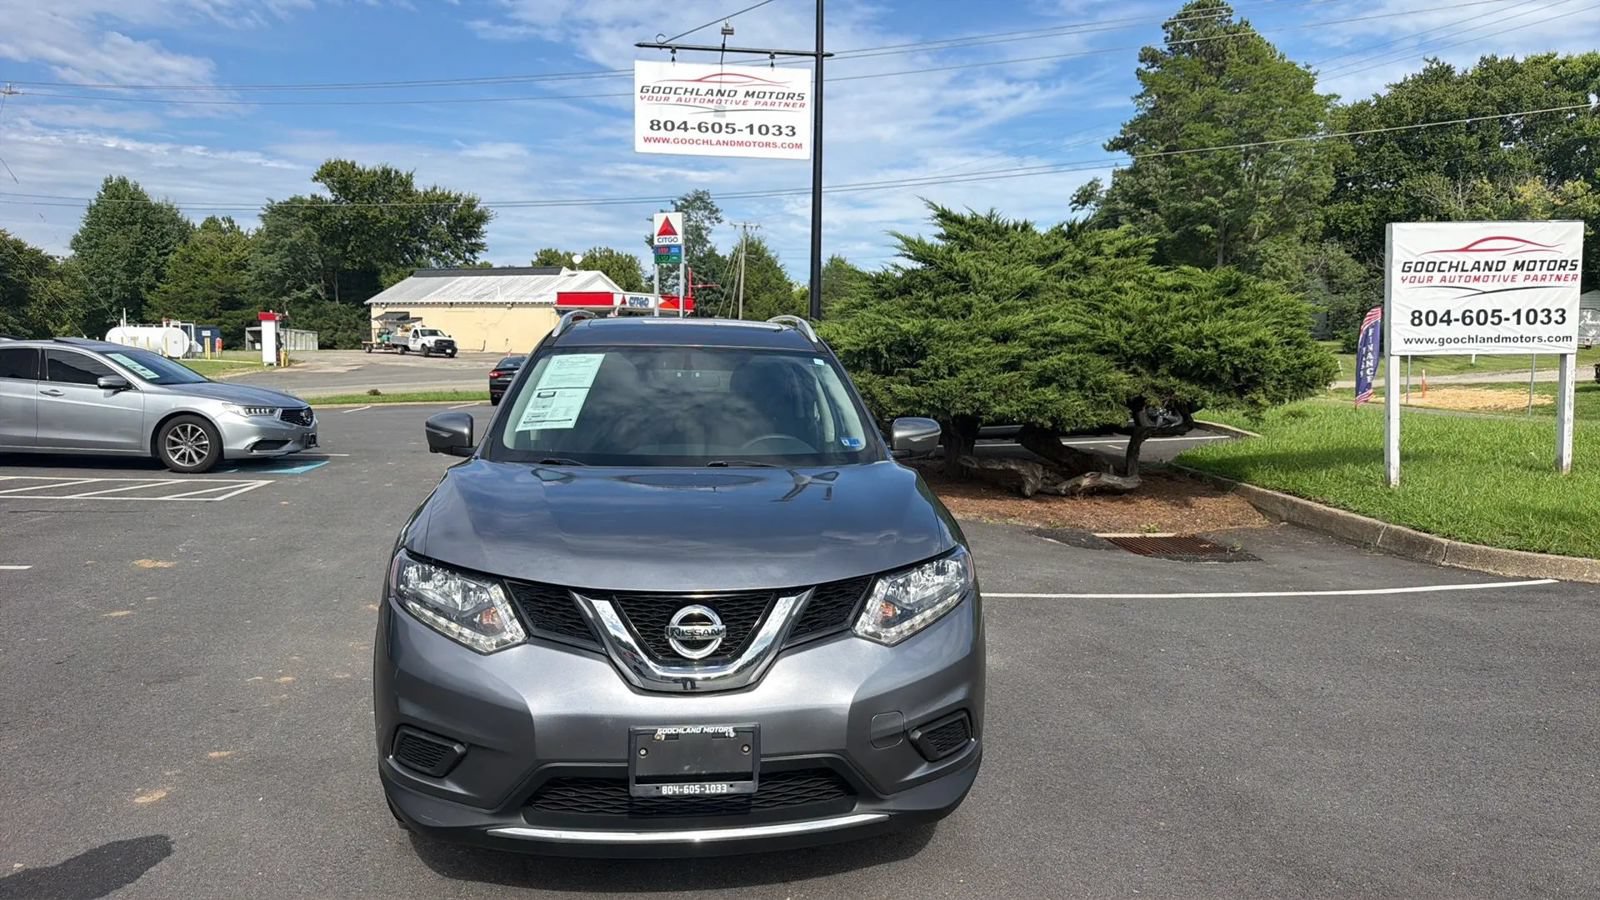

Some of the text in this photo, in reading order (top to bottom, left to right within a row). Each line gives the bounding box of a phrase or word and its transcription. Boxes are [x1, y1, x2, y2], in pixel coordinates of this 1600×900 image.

[640, 85, 806, 101] GOOCHLAND MOTORS
[676, 96, 749, 106] AUTOMOTIVE
[754, 101, 806, 109] PARTNER
[649, 119, 797, 137] 804-605-1033
[643, 136, 803, 149] WWW.GOOCHLANDMOTORS.COM
[1401, 259, 1579, 273] GOOCHLAND MOTORS
[1401, 273, 1579, 284] YOUR AUTOMOTIVE PARTNER
[1410, 308, 1567, 327] 804-605-1033
[1403, 334, 1573, 346] www.goochlandmotors.com
[1366, 328, 1375, 383] FINANCE
[670, 627, 722, 637] NISSAN
[661, 784, 727, 795] 804-605-1033
